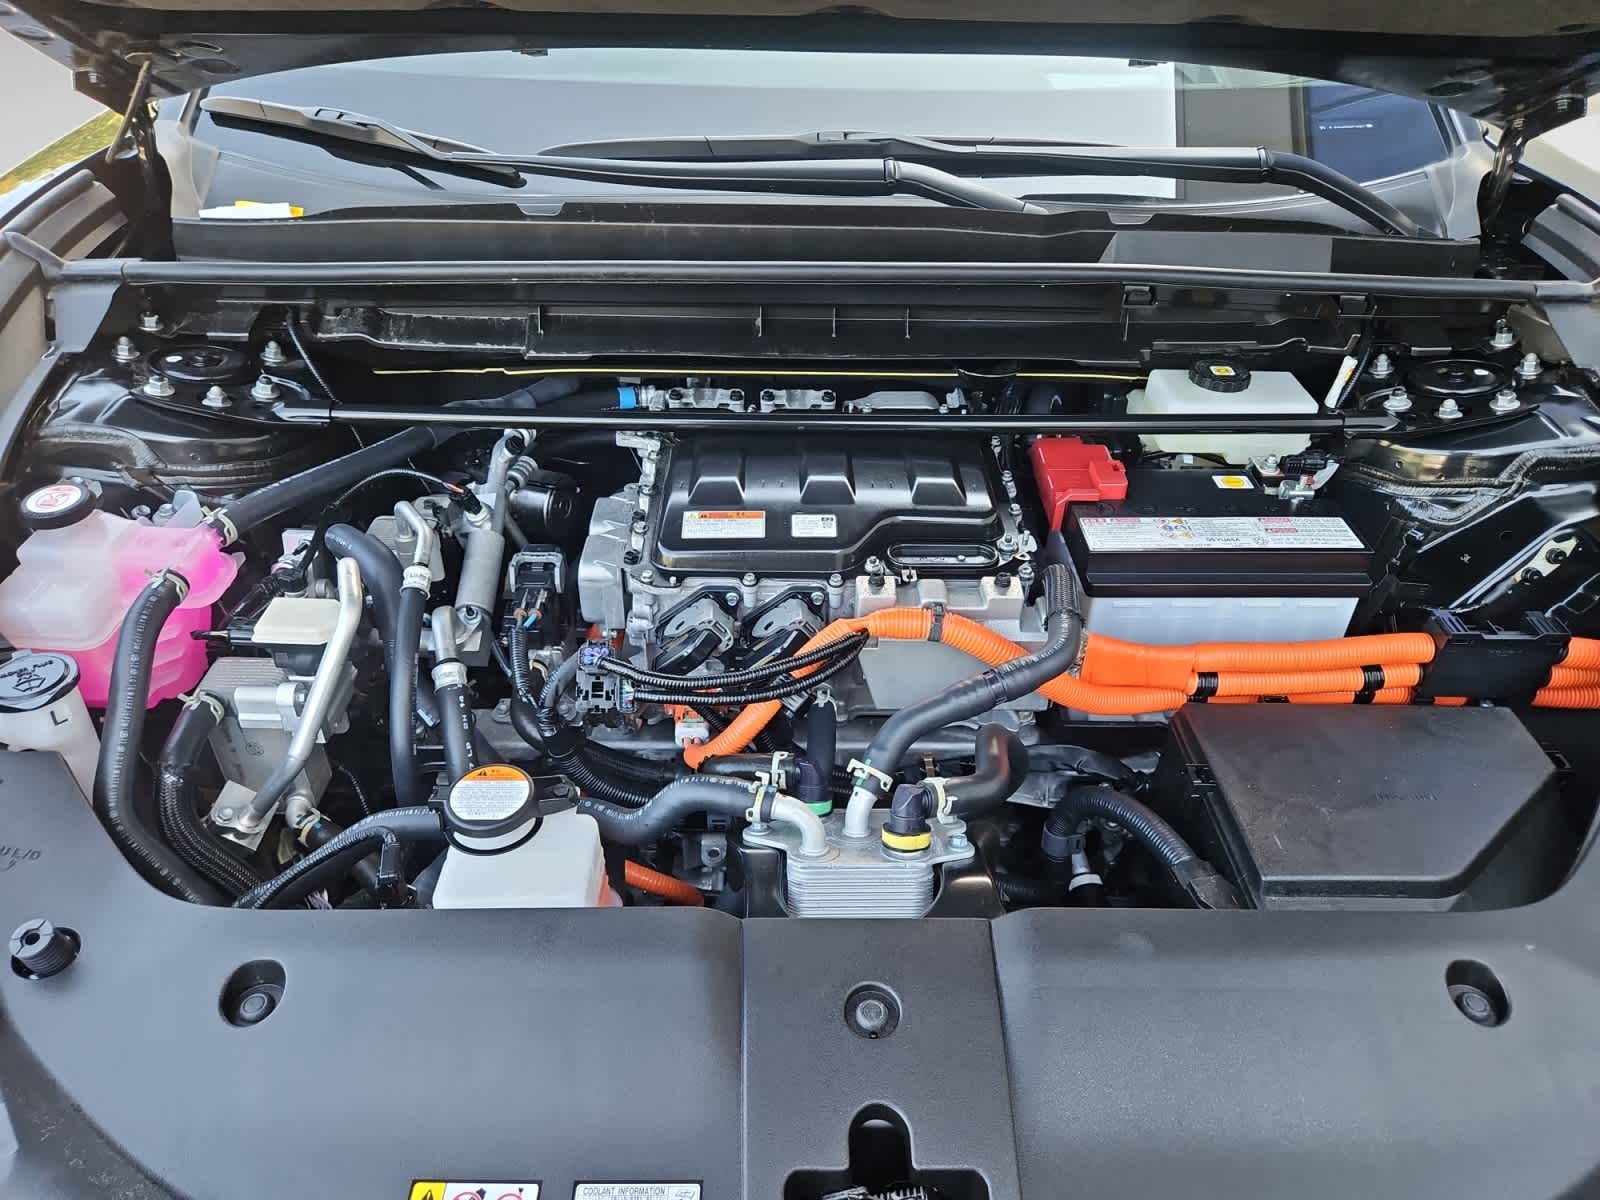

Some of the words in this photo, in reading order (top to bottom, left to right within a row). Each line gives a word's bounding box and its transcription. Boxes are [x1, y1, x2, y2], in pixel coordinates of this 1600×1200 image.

[50, 710, 69, 727] L
[583, 1187, 615, 1196] COOLANT
[618, 1187, 666, 1196] INFORMATION
